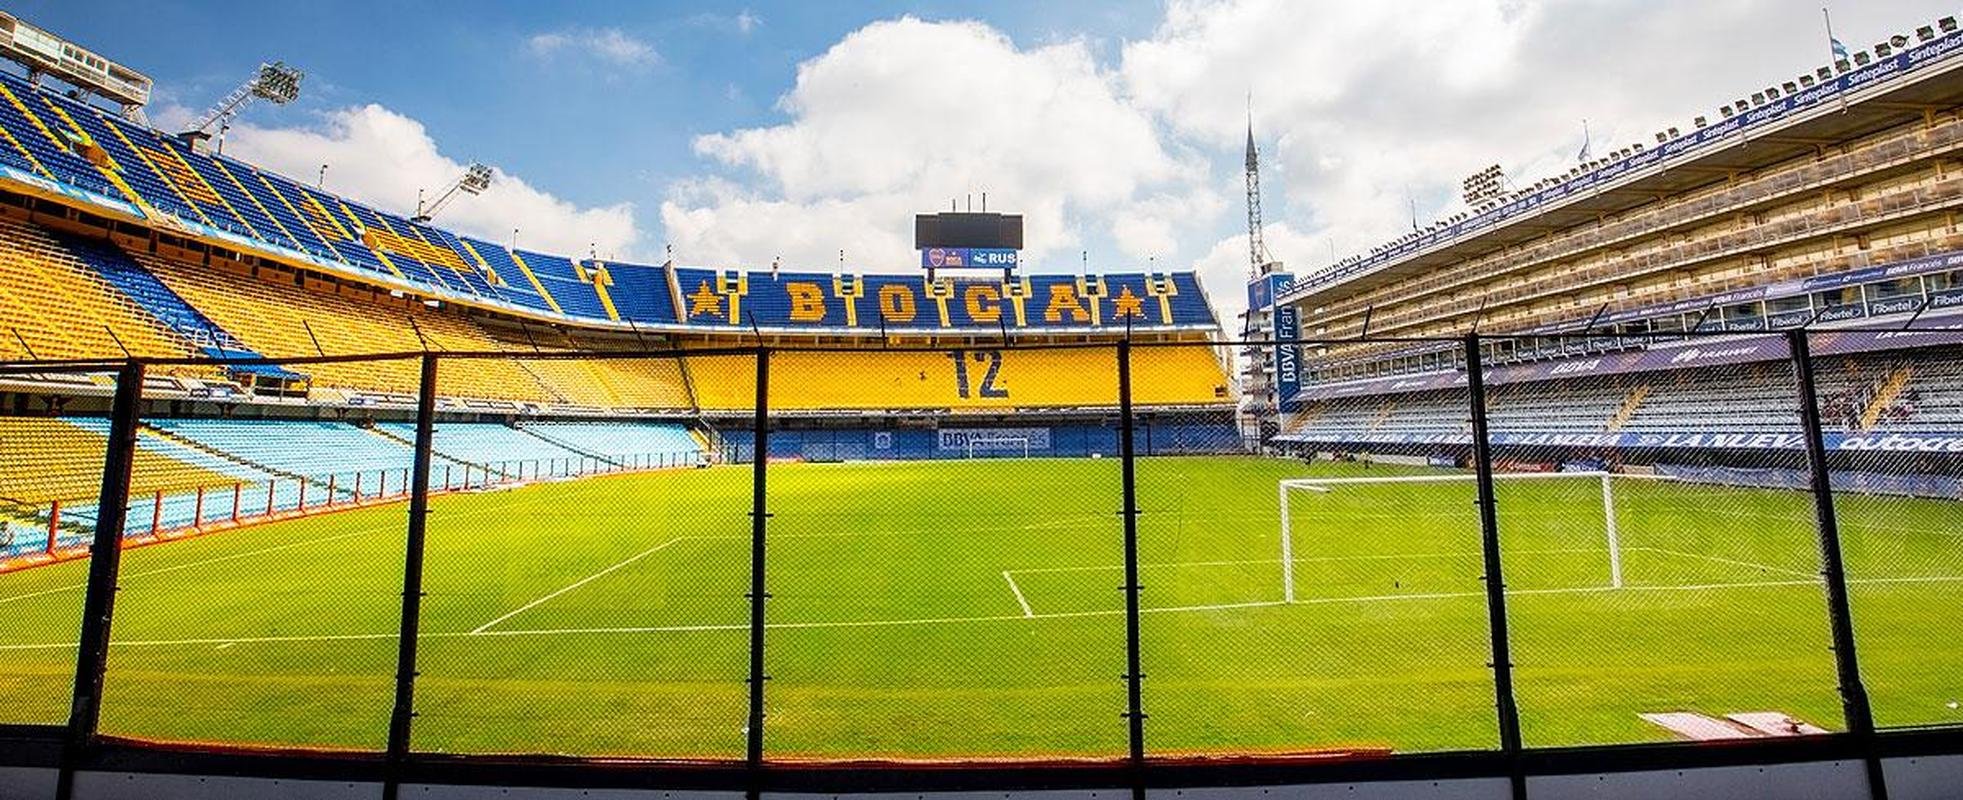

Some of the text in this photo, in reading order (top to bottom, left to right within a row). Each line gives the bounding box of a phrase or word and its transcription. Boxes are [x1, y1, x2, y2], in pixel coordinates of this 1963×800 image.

[1848, 59, 1899, 86] Sinteplast
[1794, 81, 1840, 106] Sinteplast
[989, 253, 1016, 264] RUS
[1820, 308, 1853, 321] Fibertel
[1873, 300, 1912, 314] Fibertel
[1279, 280, 1297, 383] BBVA Frans
[947, 349, 1009, 399] 12
[1663, 433, 1701, 448] LA
